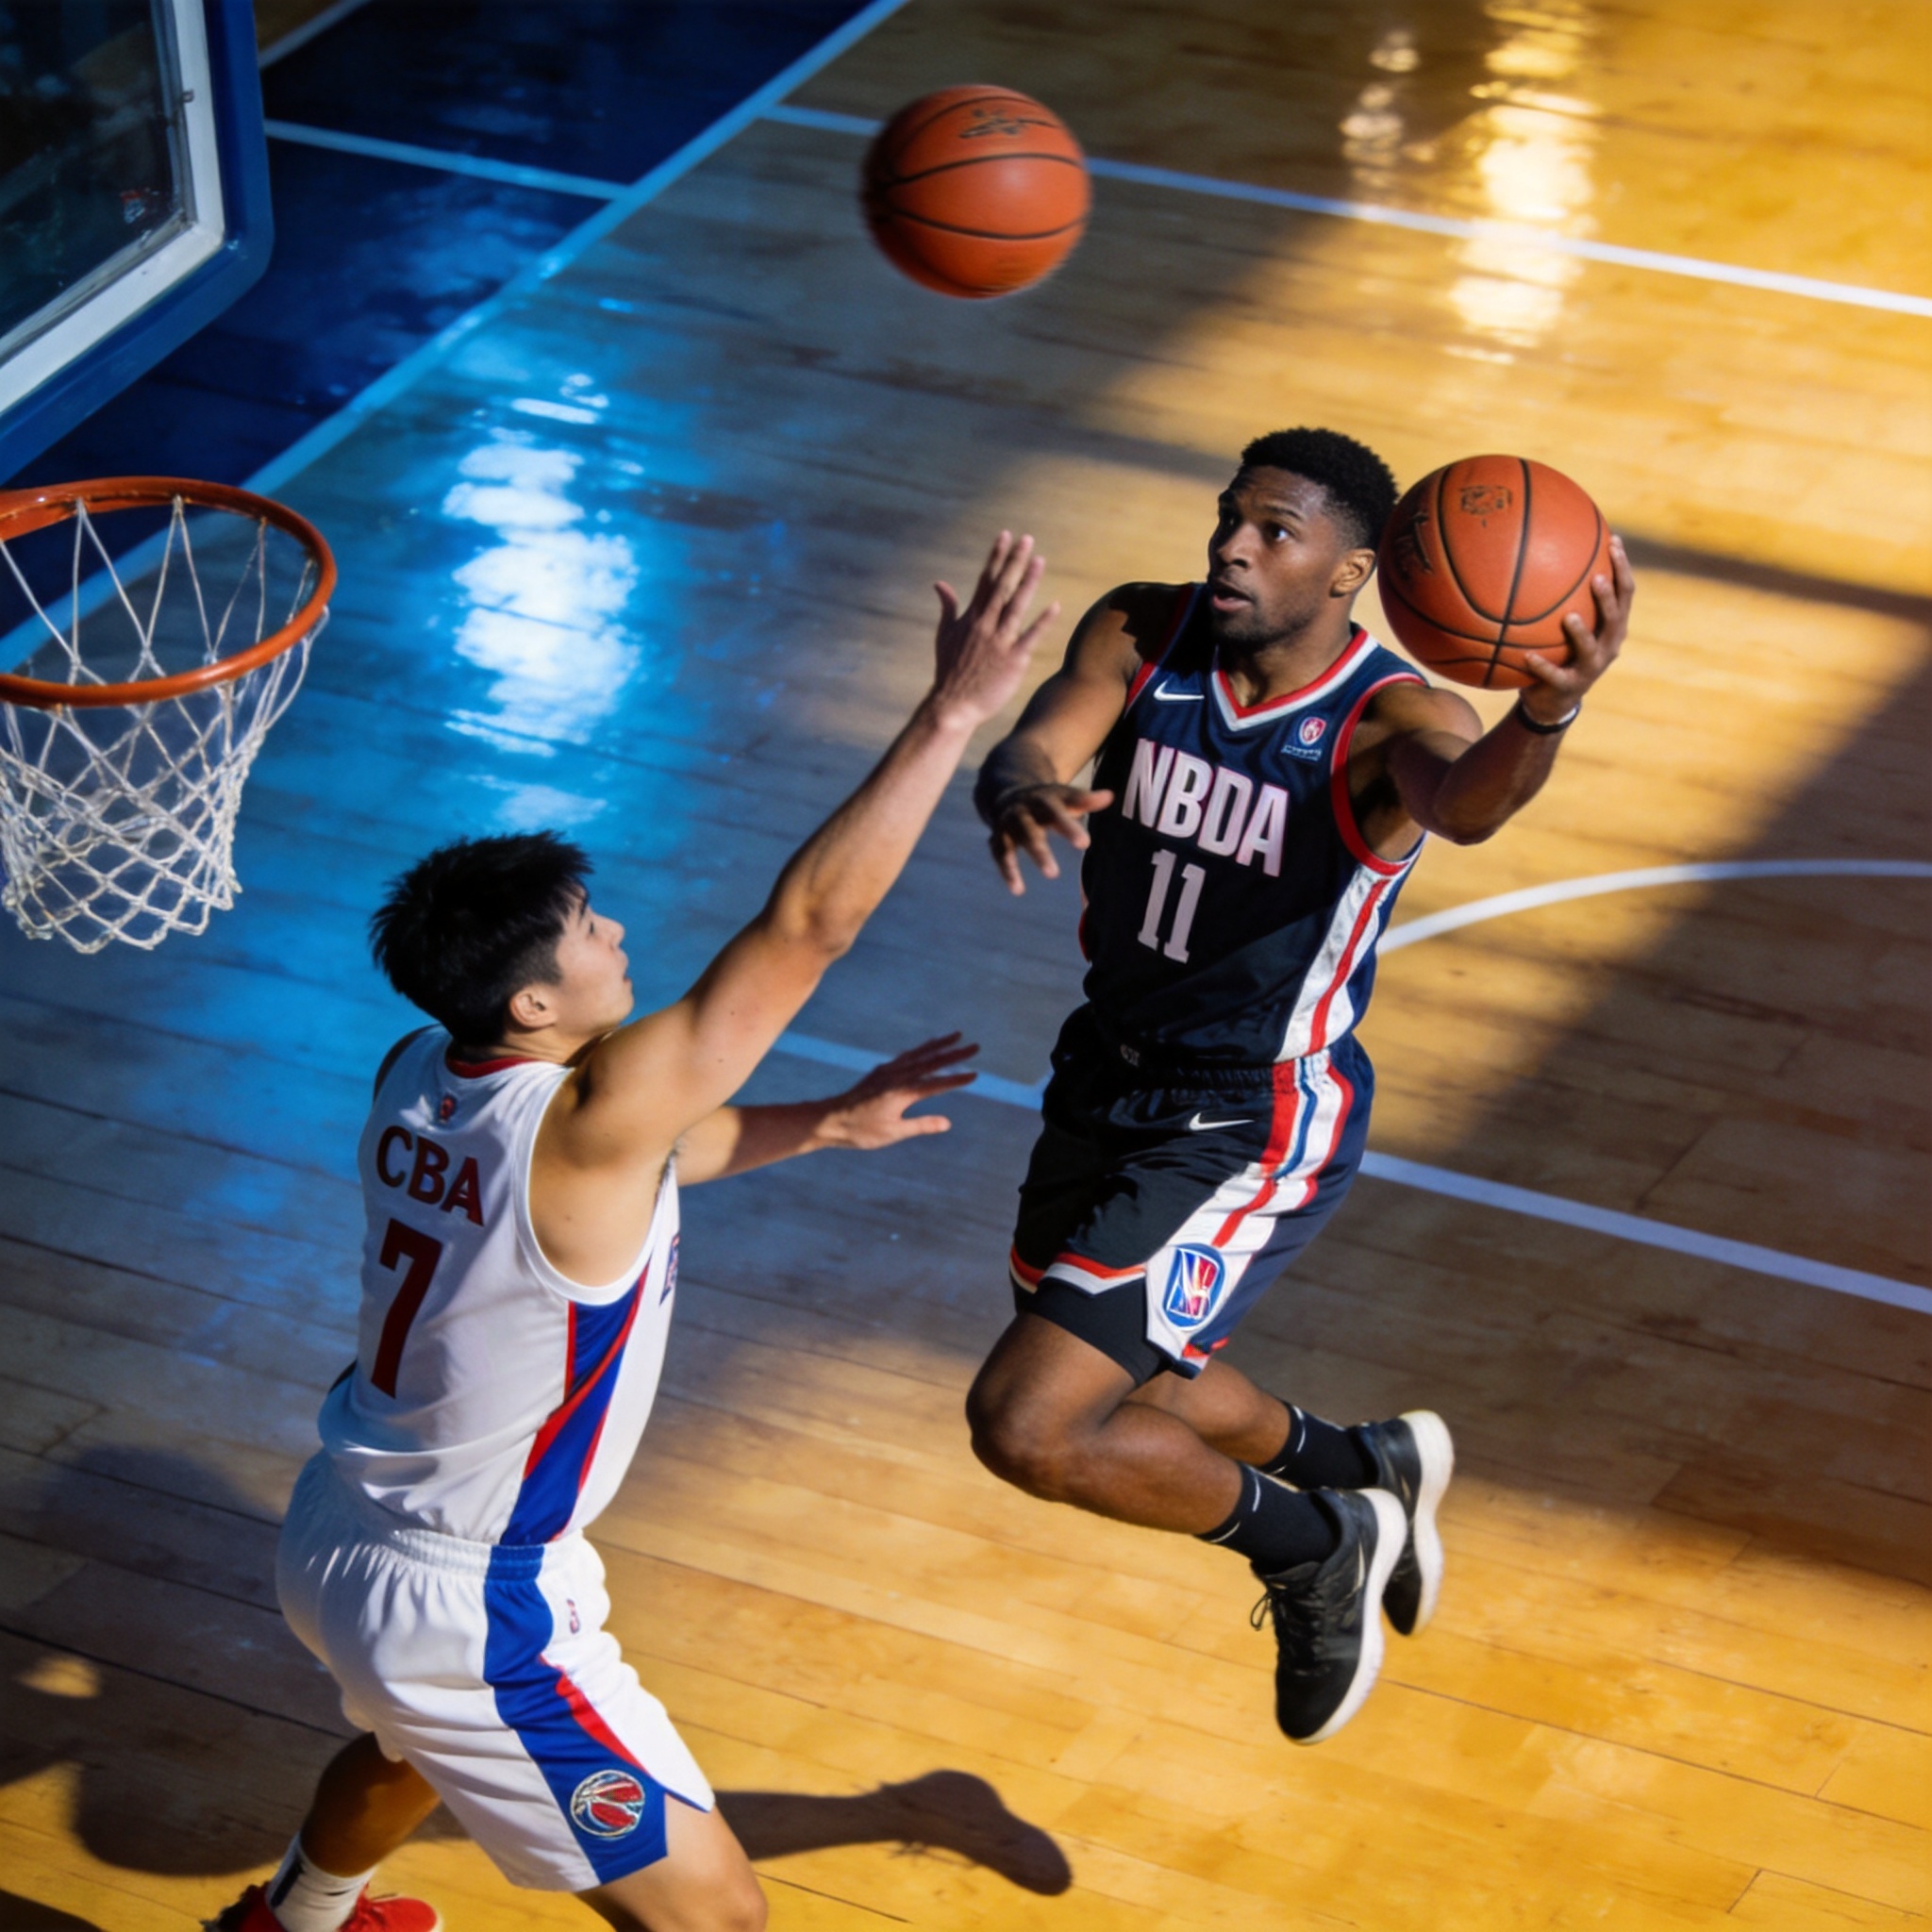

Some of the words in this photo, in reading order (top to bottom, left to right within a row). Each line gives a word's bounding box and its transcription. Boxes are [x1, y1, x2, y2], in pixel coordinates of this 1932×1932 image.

[1123, 738, 1289, 876] NBDA
[1138, 849, 1206, 963] 11
[376, 1125, 483, 1226] CBA
[372, 1219, 442, 1398] 7
